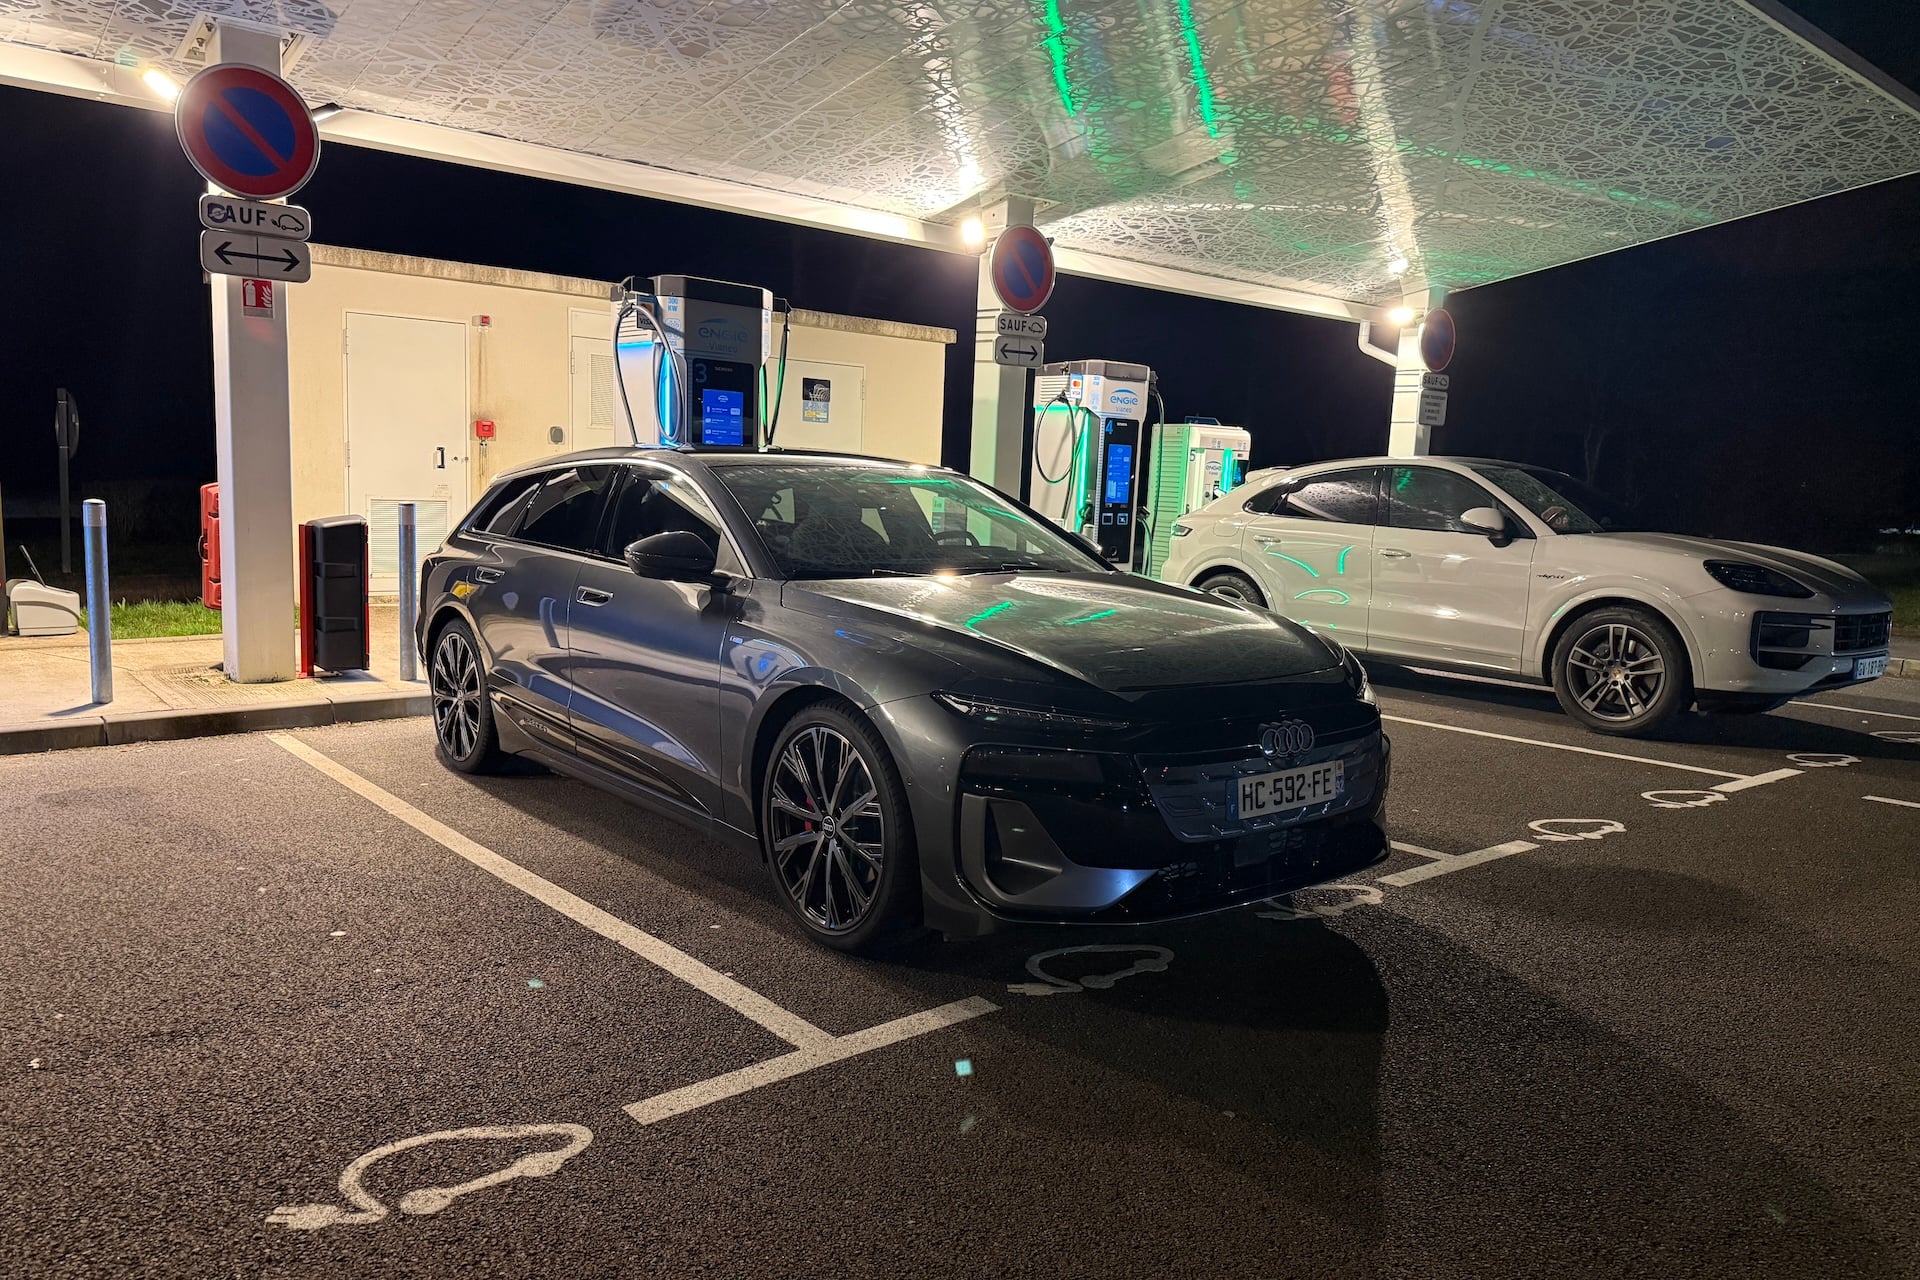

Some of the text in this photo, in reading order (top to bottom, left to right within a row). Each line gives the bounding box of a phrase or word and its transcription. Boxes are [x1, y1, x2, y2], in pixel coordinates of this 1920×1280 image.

[208, 203, 267, 226] AUF
[1000, 319, 1027, 331] SAUF
[695, 363, 707, 383] 3
[1106, 420, 1113, 434] 4
